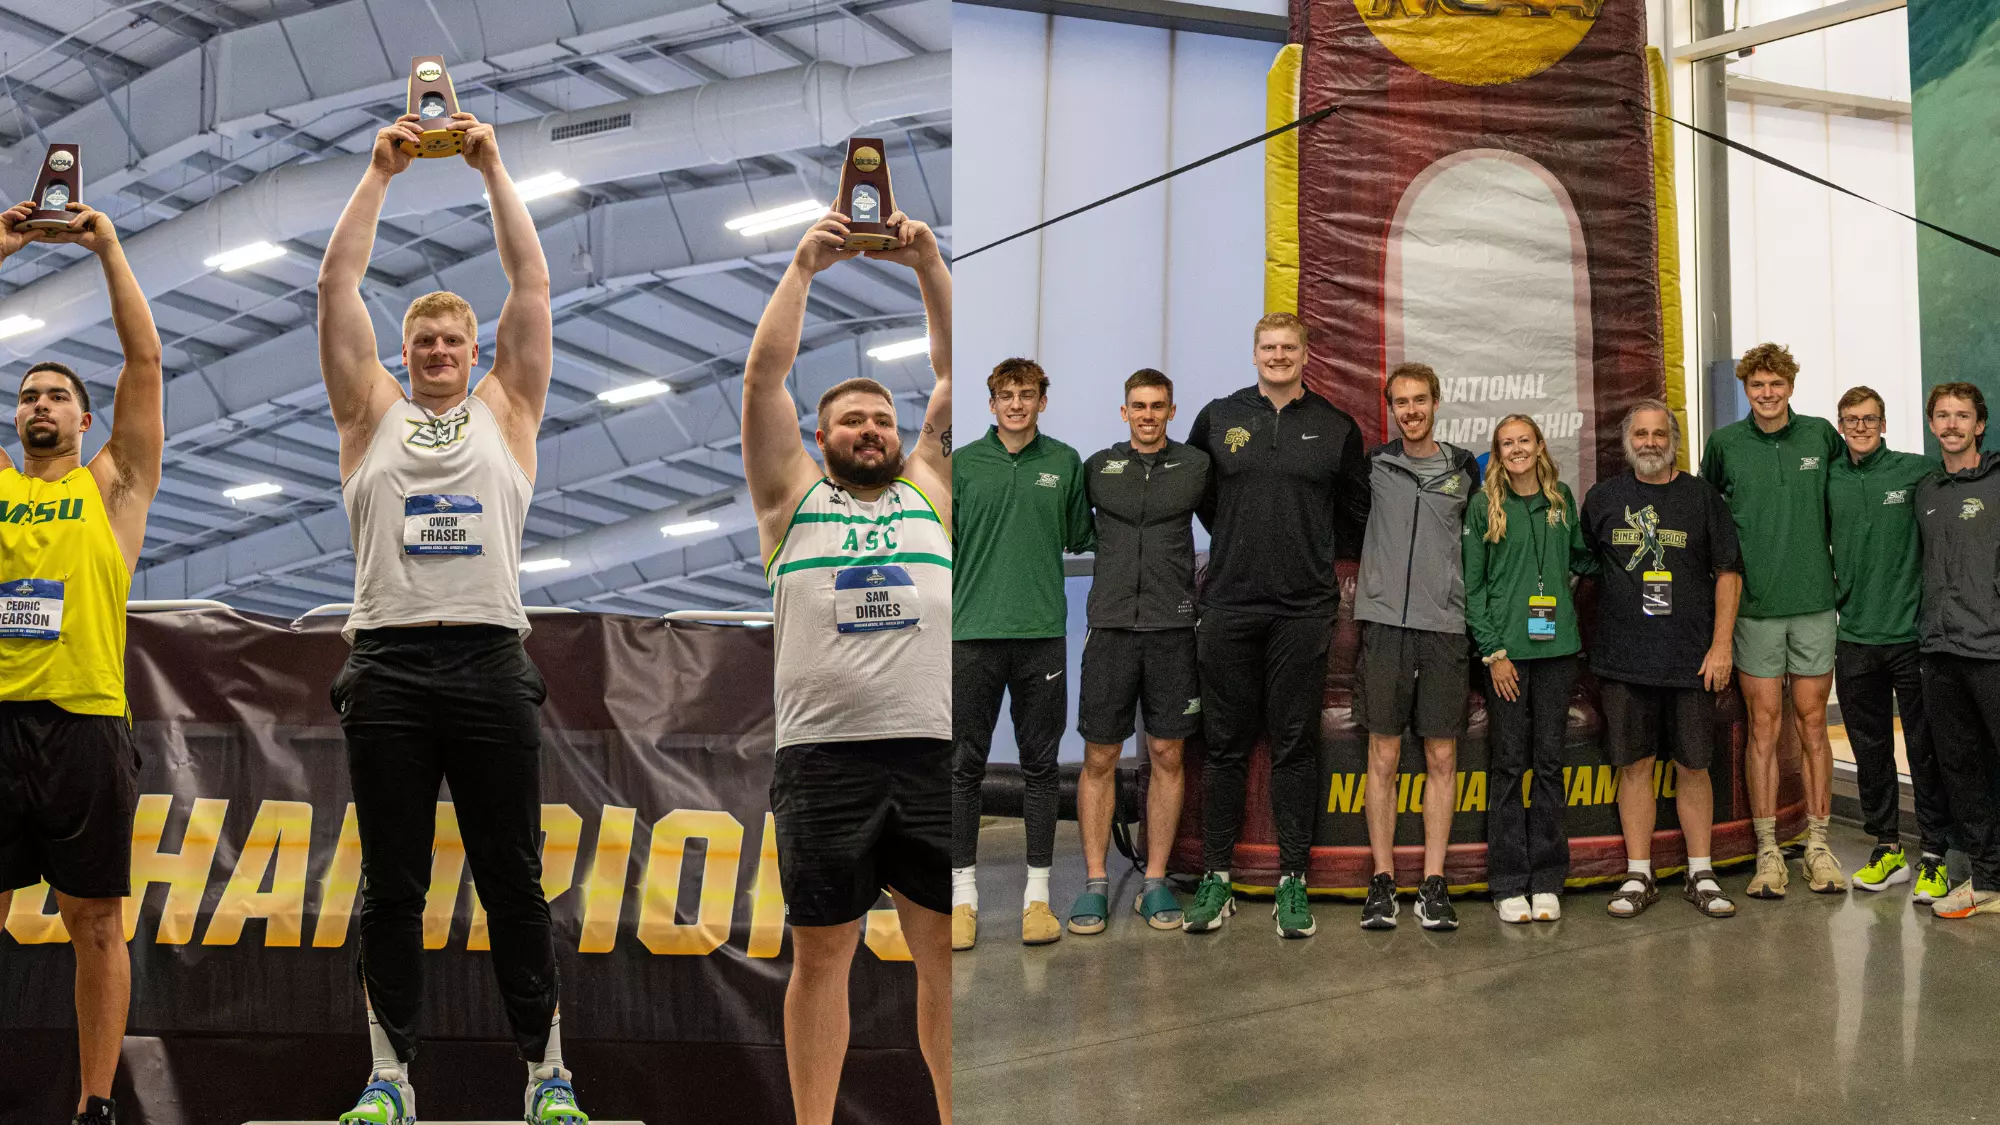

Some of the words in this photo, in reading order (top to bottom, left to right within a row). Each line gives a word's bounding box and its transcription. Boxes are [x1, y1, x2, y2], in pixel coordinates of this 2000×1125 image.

[1440, 374, 1548, 402] NATIONAL
[429, 517, 458, 527] OWEN
[420, 529, 467, 542] FRASER
[841, 526, 897, 551] ASC
[1613, 531, 1640, 541] MINER
[1660, 533, 1686, 544] PRIDE
[865, 590, 889, 603] SAM
[6, 600, 41, 611] CEDRIC
[855, 603, 901, 619] DIRKES
[0, 612, 50, 627] EARSON
